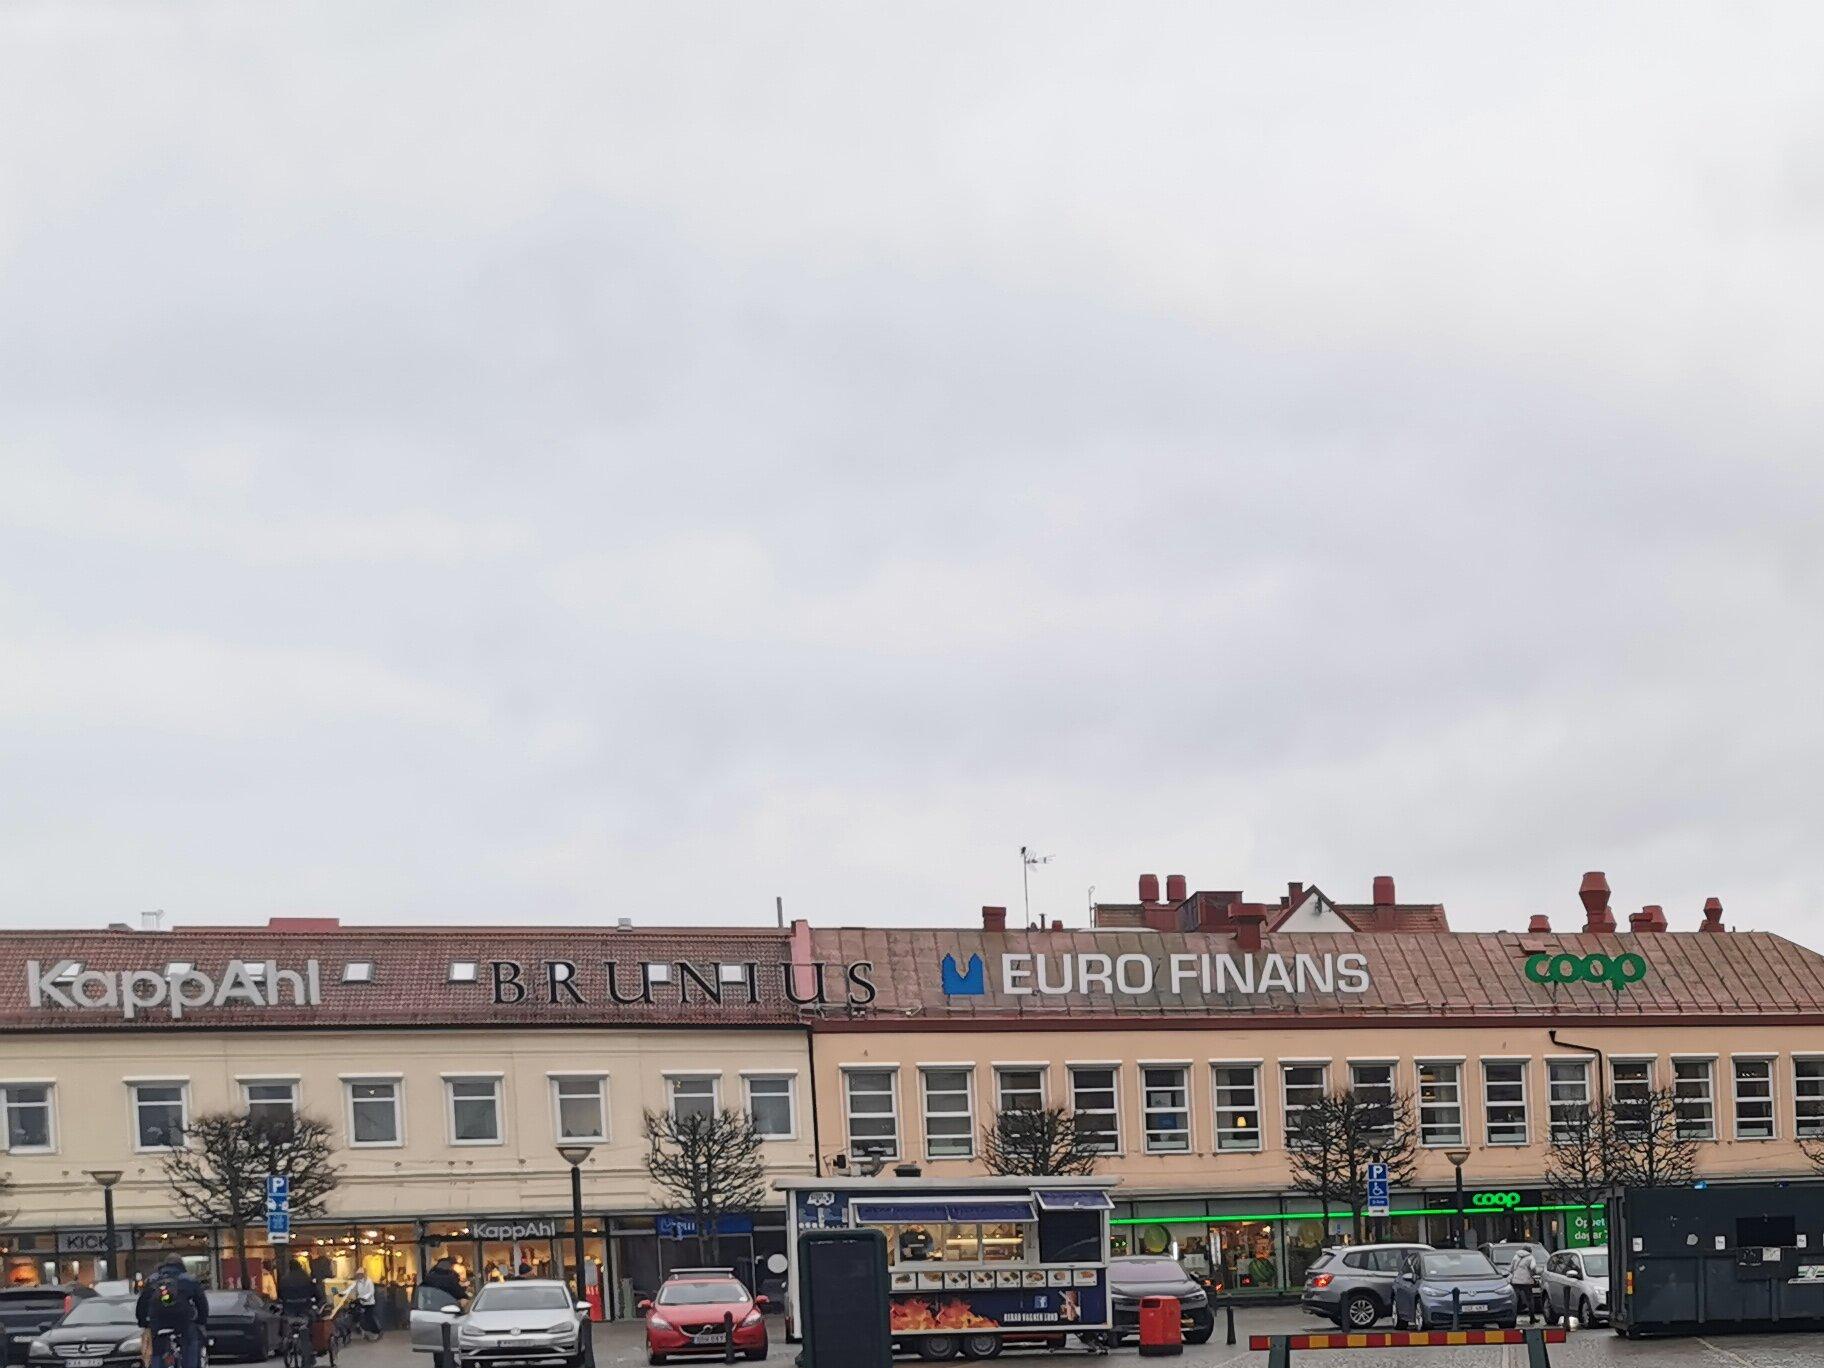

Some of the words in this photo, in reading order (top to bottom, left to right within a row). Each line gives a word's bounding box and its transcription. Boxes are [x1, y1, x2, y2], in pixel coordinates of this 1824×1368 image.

[490, 961, 878, 1005] BRUNIUS
[1002, 953, 1153, 995] EURO
[1170, 953, 1370, 994] FINANS
[1525, 953, 1646, 990] coop
[27, 959, 321, 1018] KappAhl
[273, 1178, 284, 1193] P
[1373, 1166, 1383, 1179] P
[1473, 1192, 1520, 1207] coop
[473, 1221, 556, 1241] KappAhl
